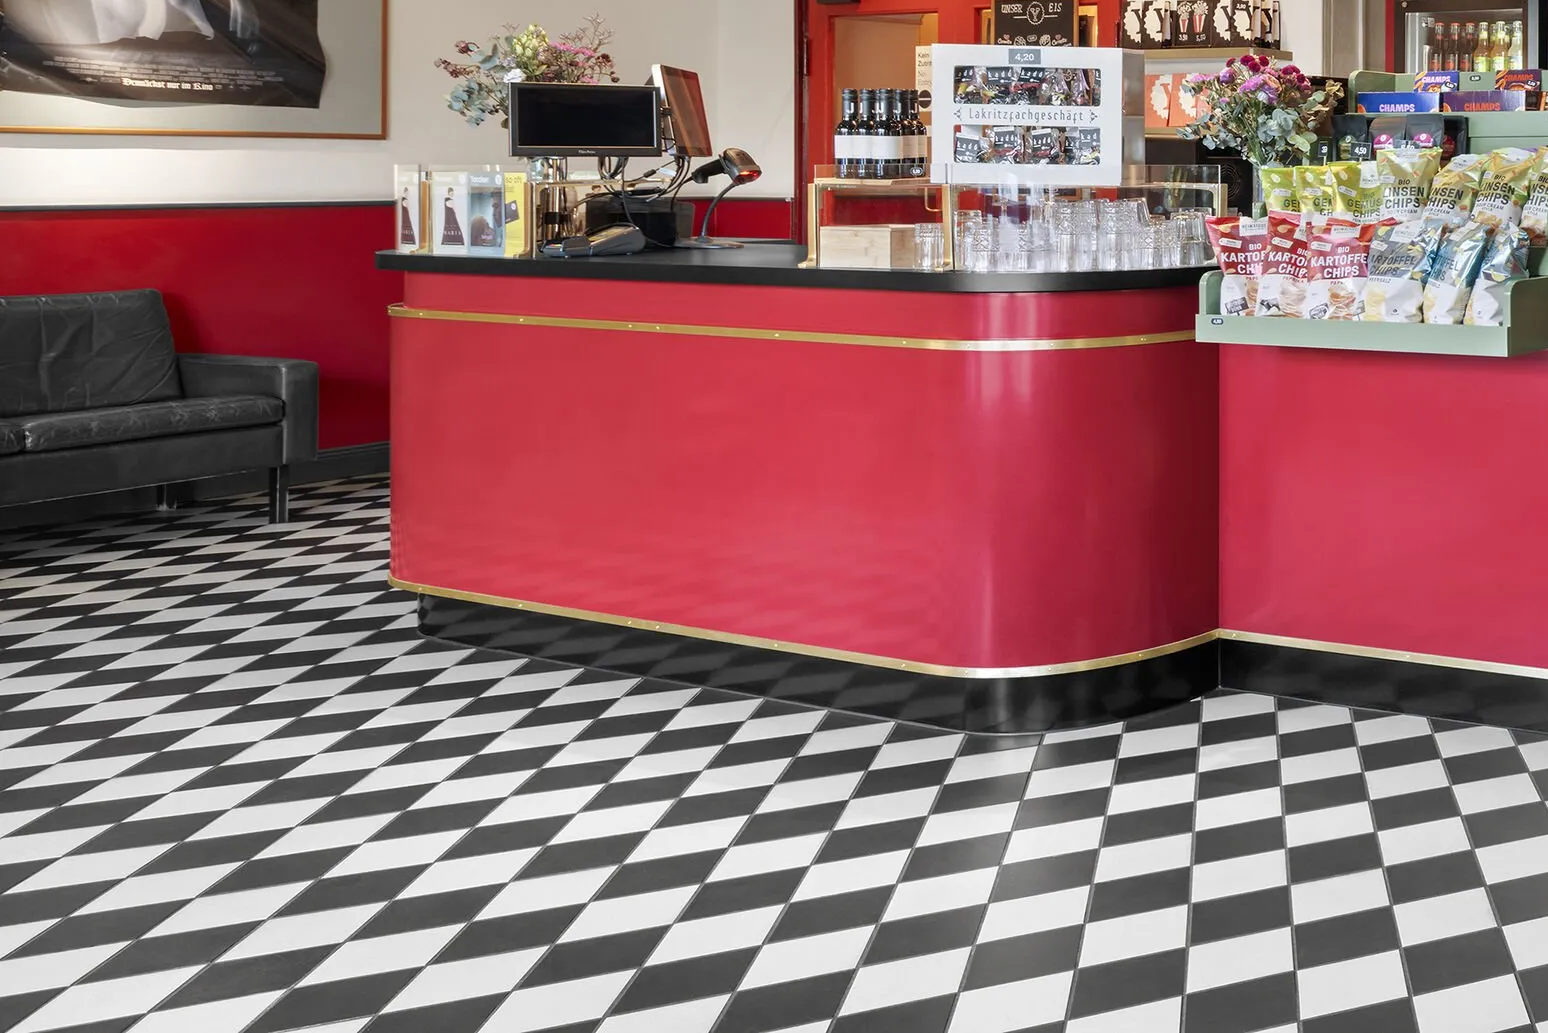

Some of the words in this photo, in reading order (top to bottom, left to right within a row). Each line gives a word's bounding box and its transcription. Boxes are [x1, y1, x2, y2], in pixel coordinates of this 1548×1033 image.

[1001, 4, 1023, 13] UNSER
[1049, 3, 1062, 12] EIS
[1014, 53, 1034, 62] 4,20
[1379, 104, 1415, 112] CHAMPS
[1464, 103, 1500, 111] CHAMPS
[969, 108, 1084, 123] Lakritzfachgeschäft
[1354, 147, 1367, 155] 4,50
[1383, 186, 1425, 198] LINSEN
[1385, 198, 1421, 209] CHIPS
[1429, 197, 1457, 210] HIPS
[1477, 192, 1510, 206] CHIPS
[1324, 265, 1359, 278] CHIPS
